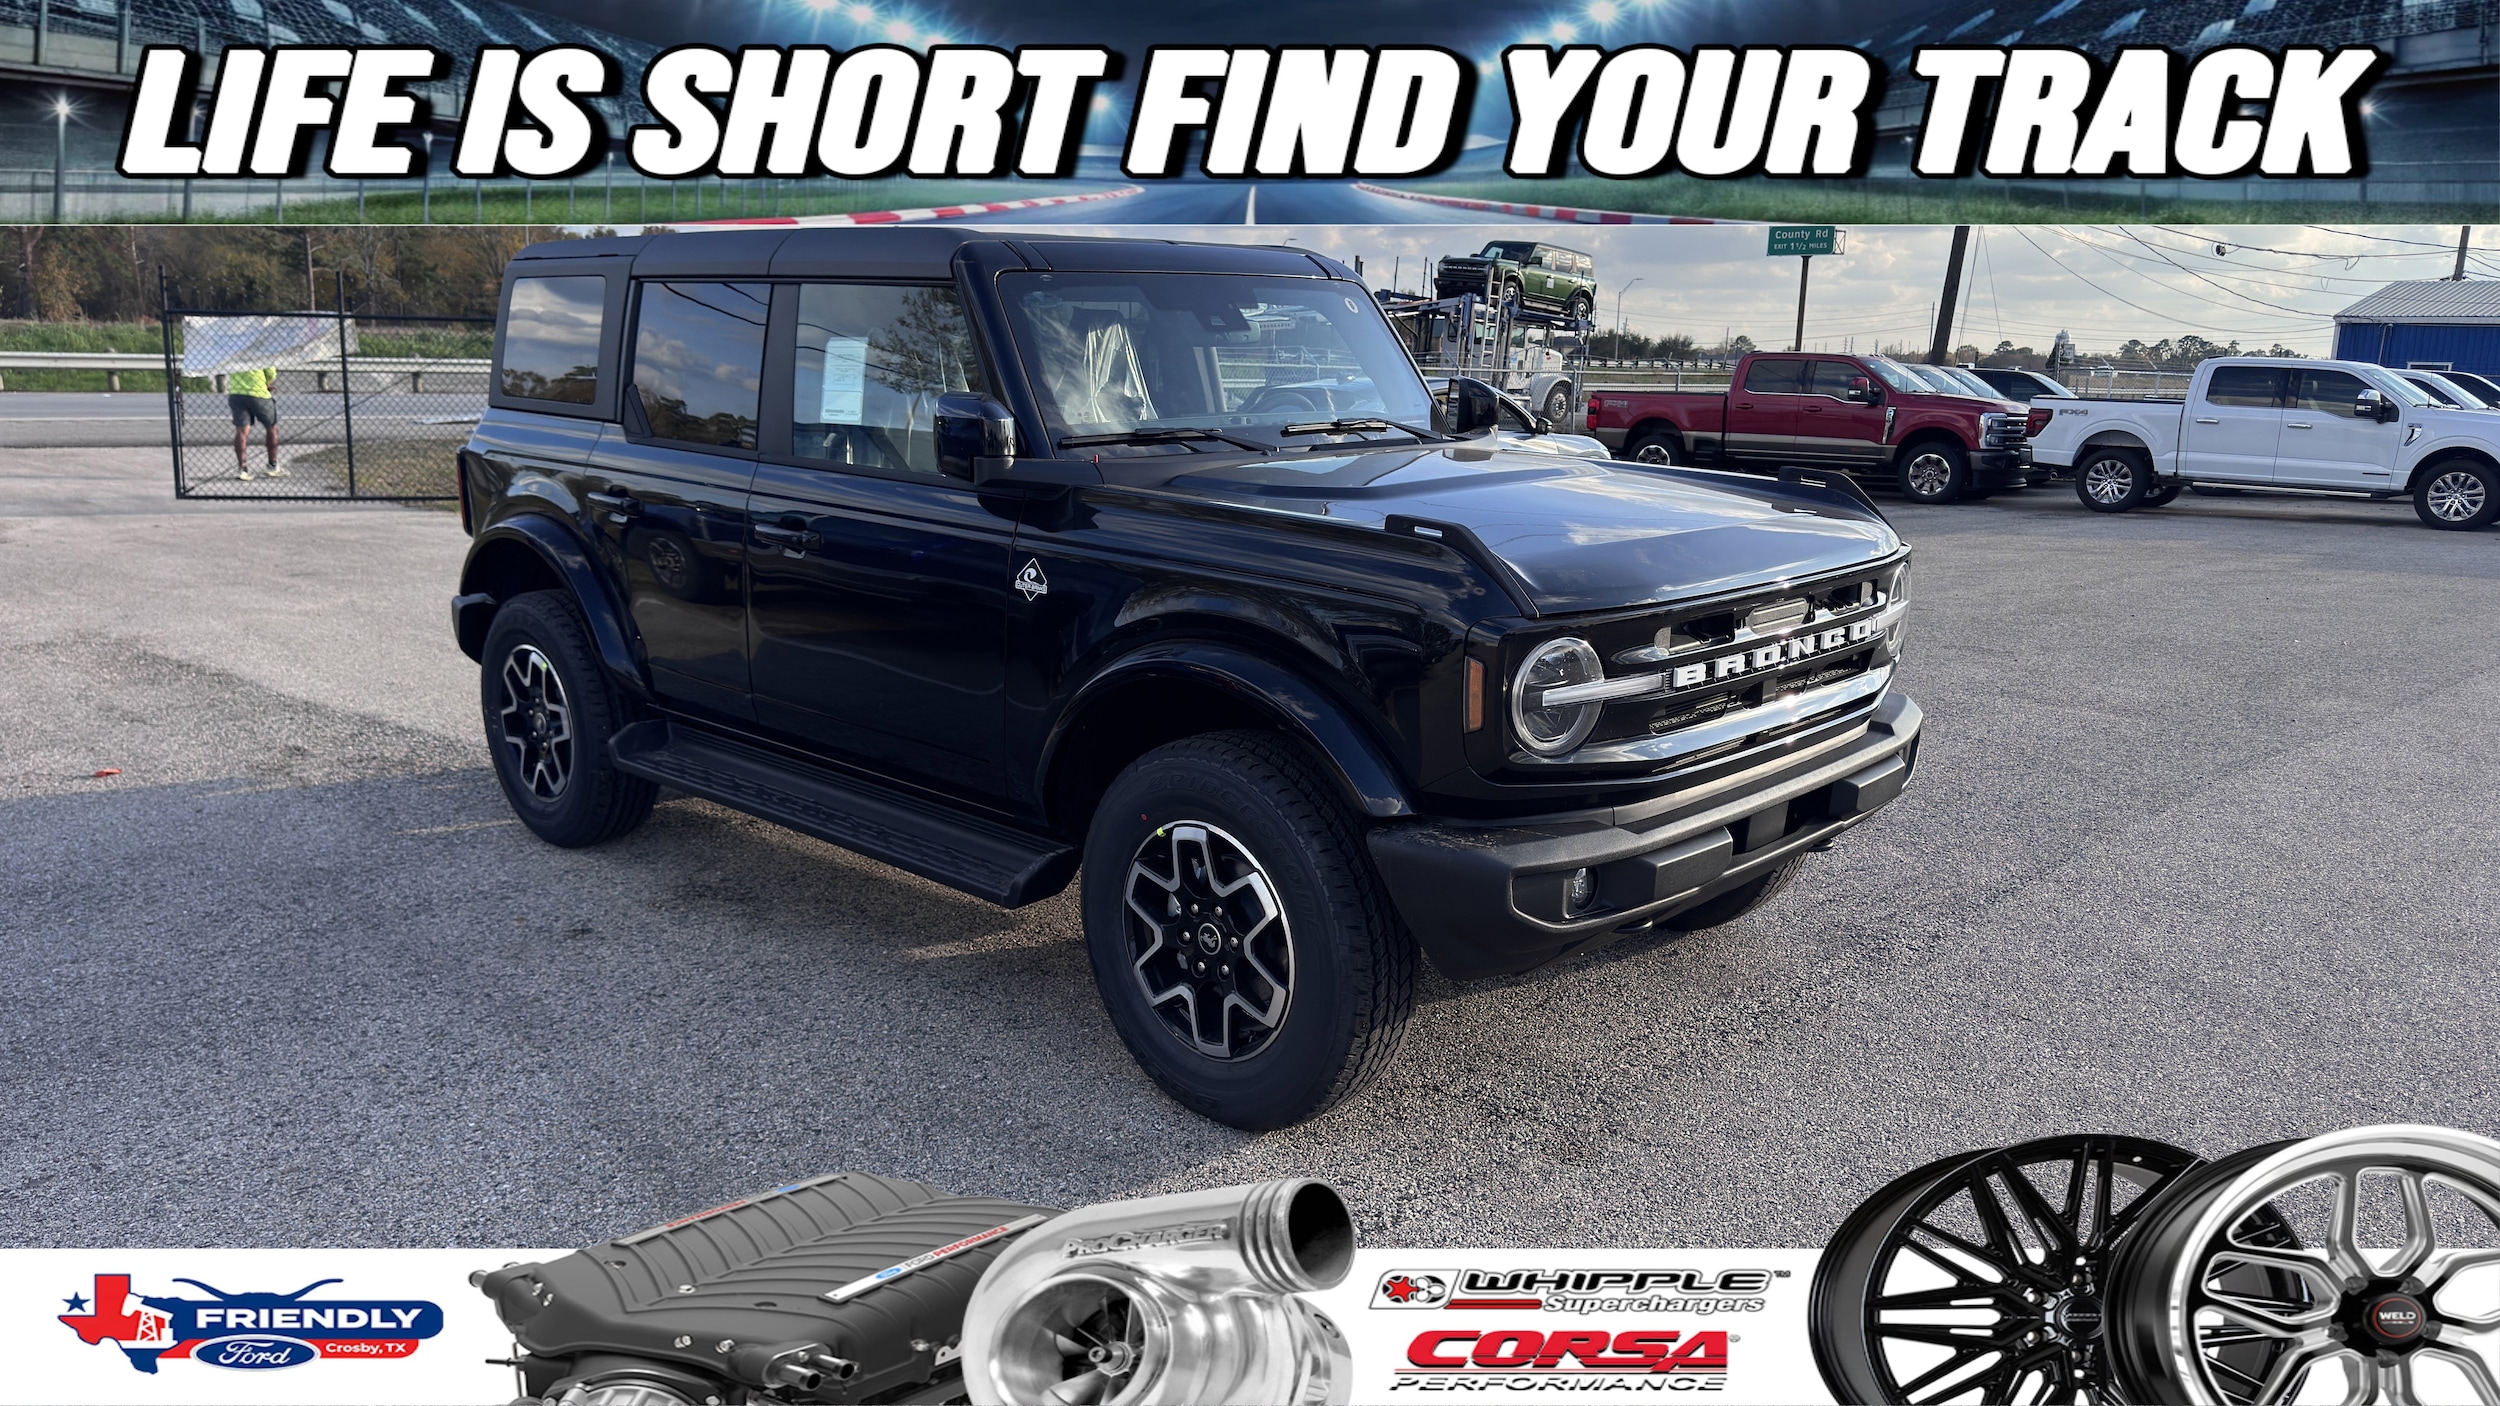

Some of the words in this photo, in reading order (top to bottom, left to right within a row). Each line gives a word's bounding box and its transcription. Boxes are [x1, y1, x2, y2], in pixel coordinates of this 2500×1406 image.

[1775, 230, 1810, 240] County
[1815, 229, 1828, 238] Rd
[2059, 408, 2089, 416] FX4
[1672, 618, 1873, 689] BRONCO
